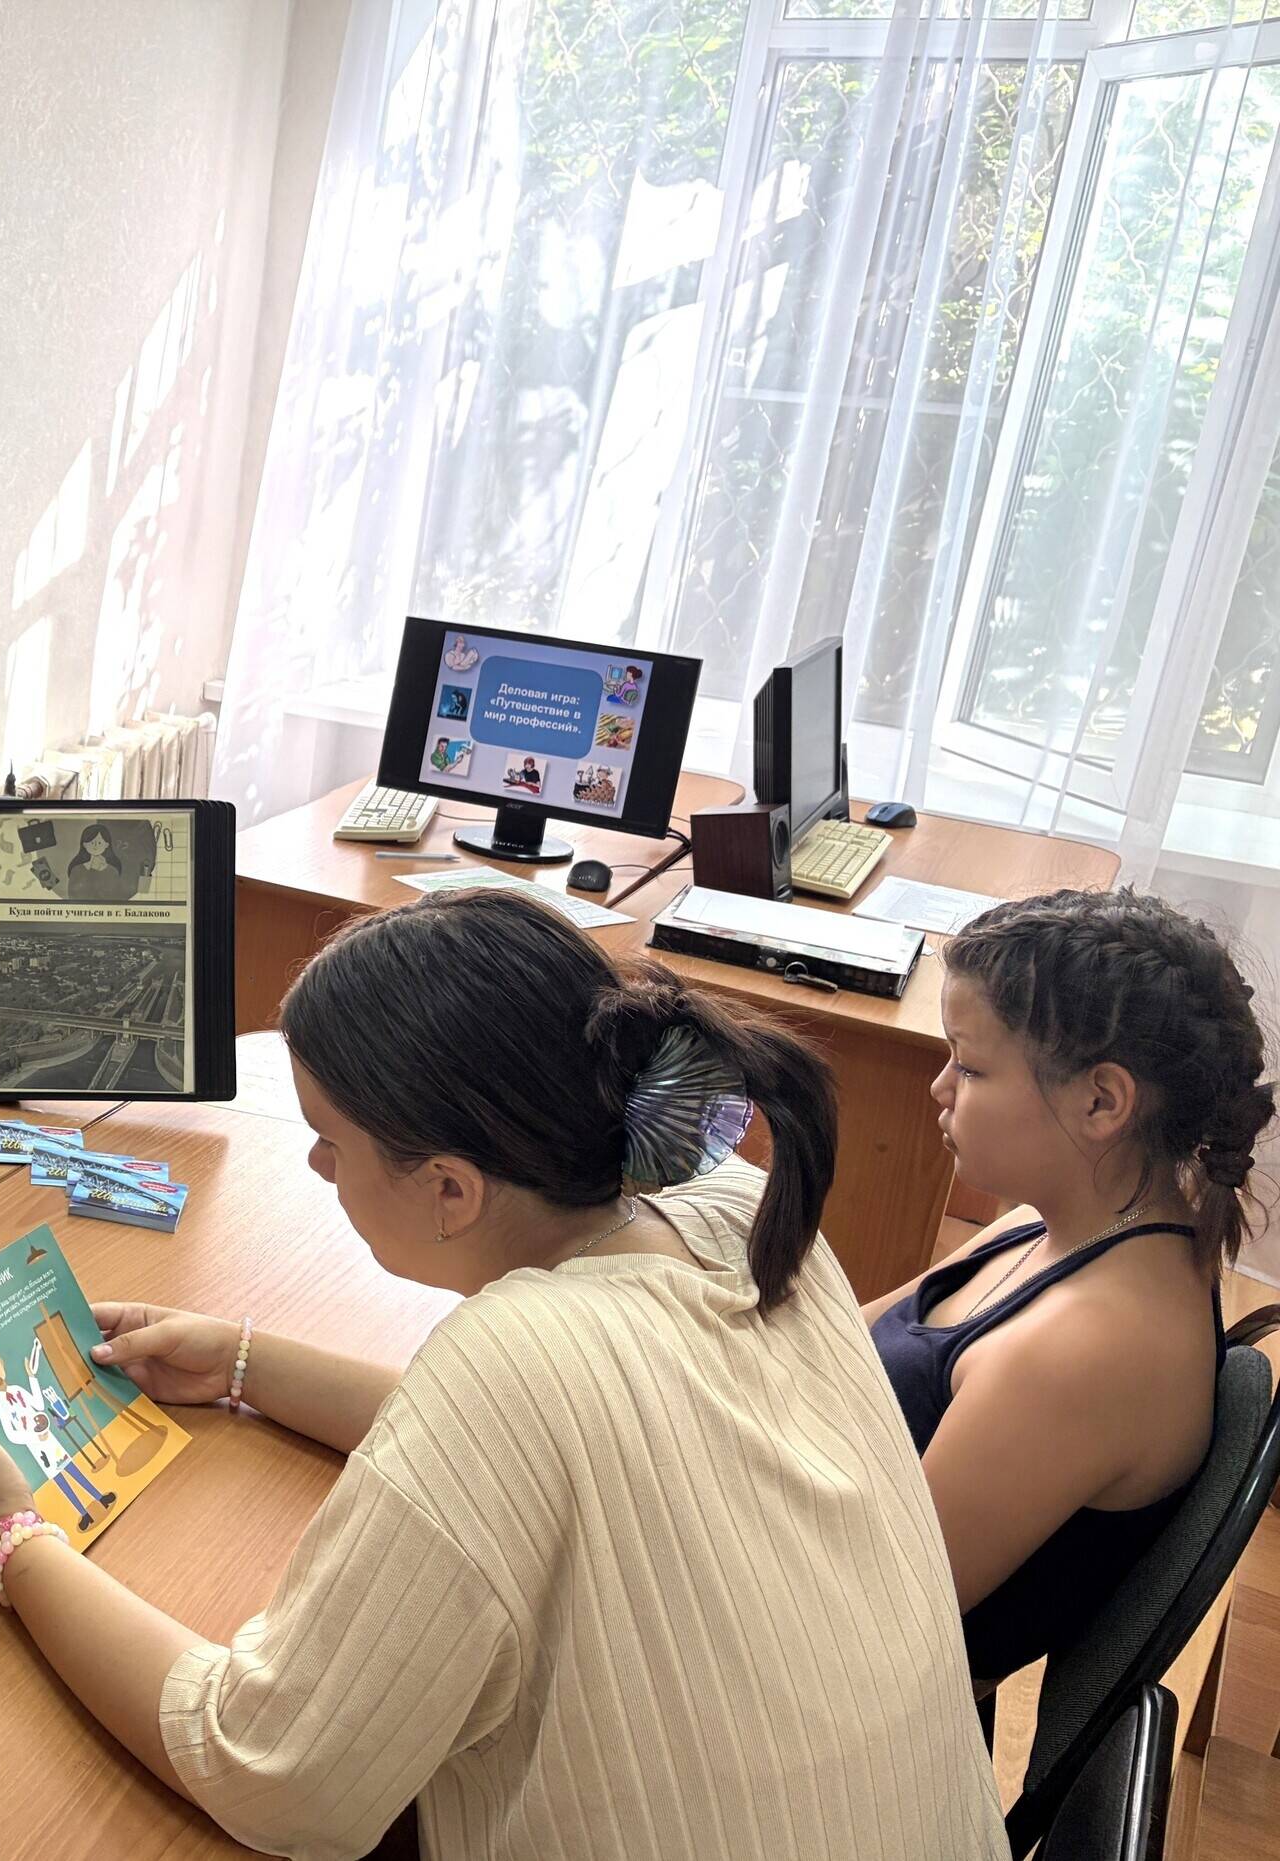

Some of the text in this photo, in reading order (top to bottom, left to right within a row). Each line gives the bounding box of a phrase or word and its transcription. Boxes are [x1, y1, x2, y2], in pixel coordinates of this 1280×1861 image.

[498, 683, 580, 705] Деловая игра:
[490, 696, 581, 720] «Путешествие в
[483, 711, 581, 734] мир профессий».
[9, 906, 31, 917] Куда
[34, 906, 62, 917] пойти
[65, 908, 104, 919] учиться
[107, 909, 112, 917] в
[124, 908, 170, 918] Балаково
